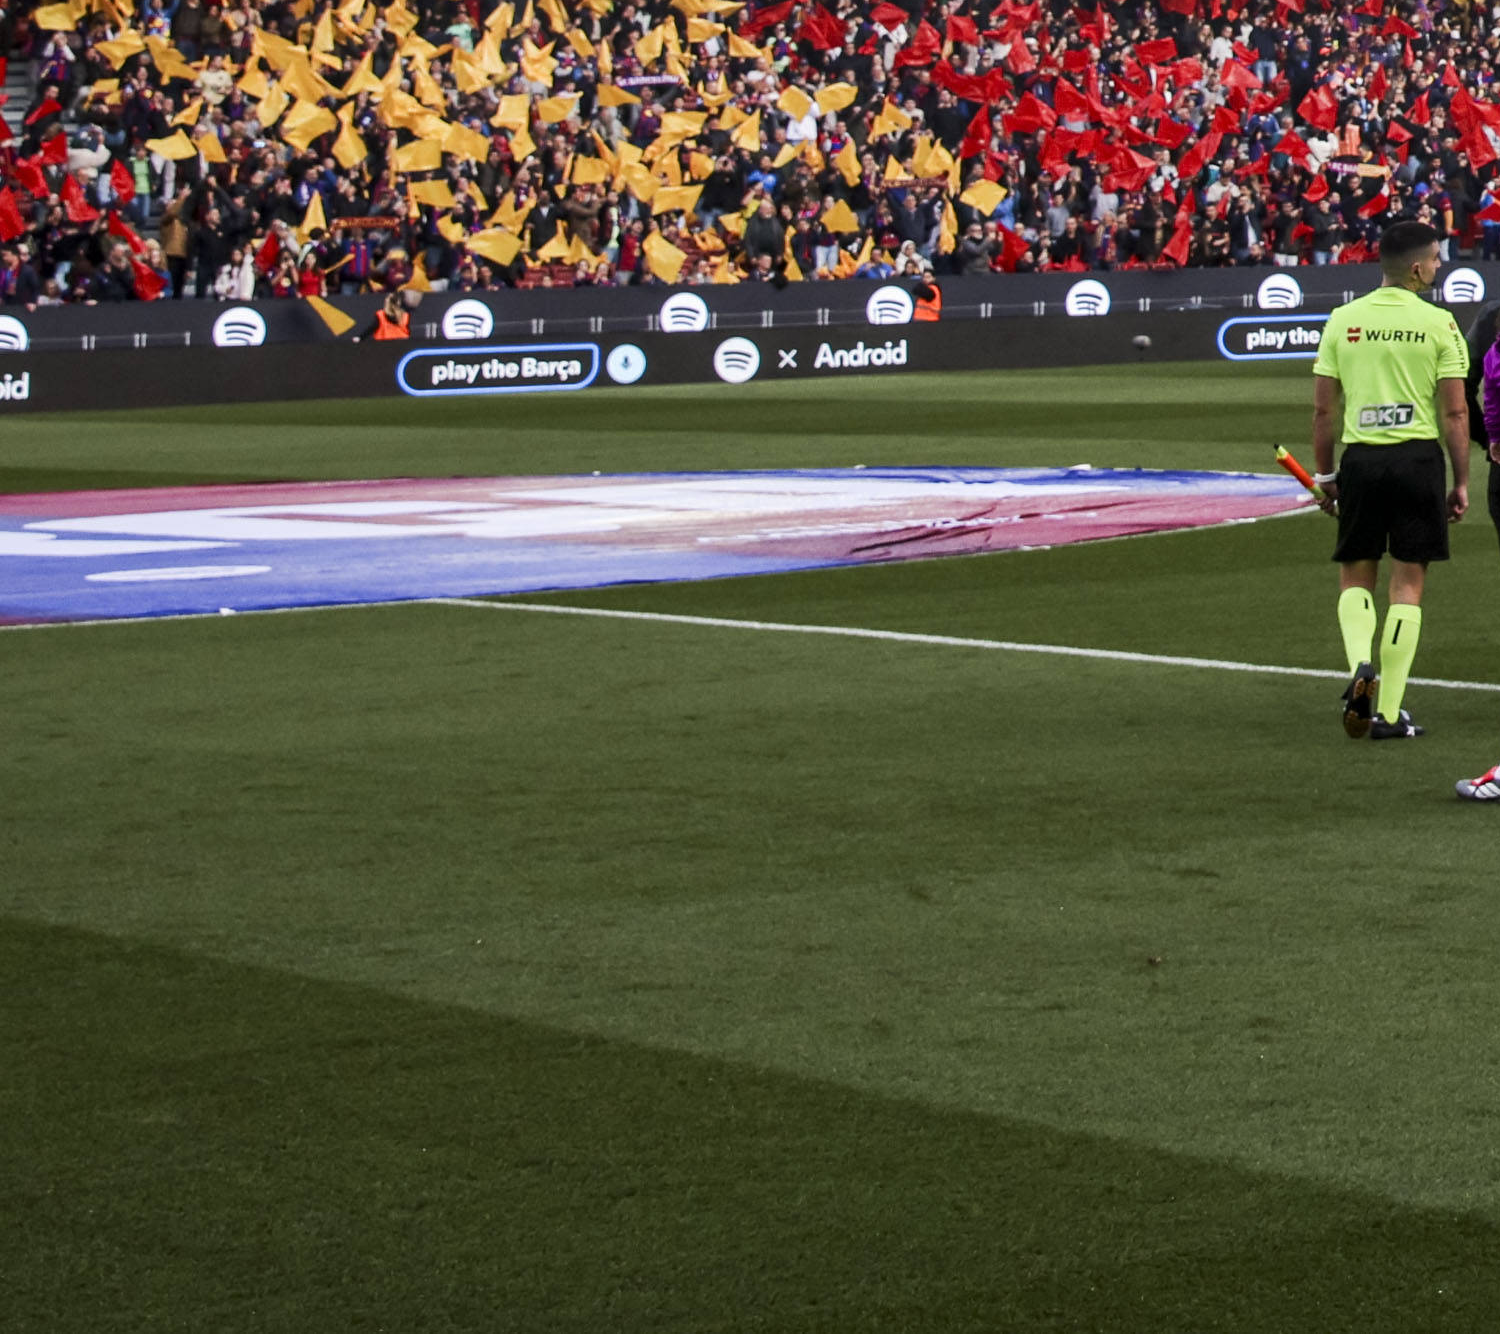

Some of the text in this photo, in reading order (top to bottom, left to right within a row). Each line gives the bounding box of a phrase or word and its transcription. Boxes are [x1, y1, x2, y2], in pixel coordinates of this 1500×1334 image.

[1246, 327, 1321, 350] play the
[814, 339, 908, 369] Android
[432, 357, 581, 385] play the Barça
[1360, 404, 1414, 428] BKT
